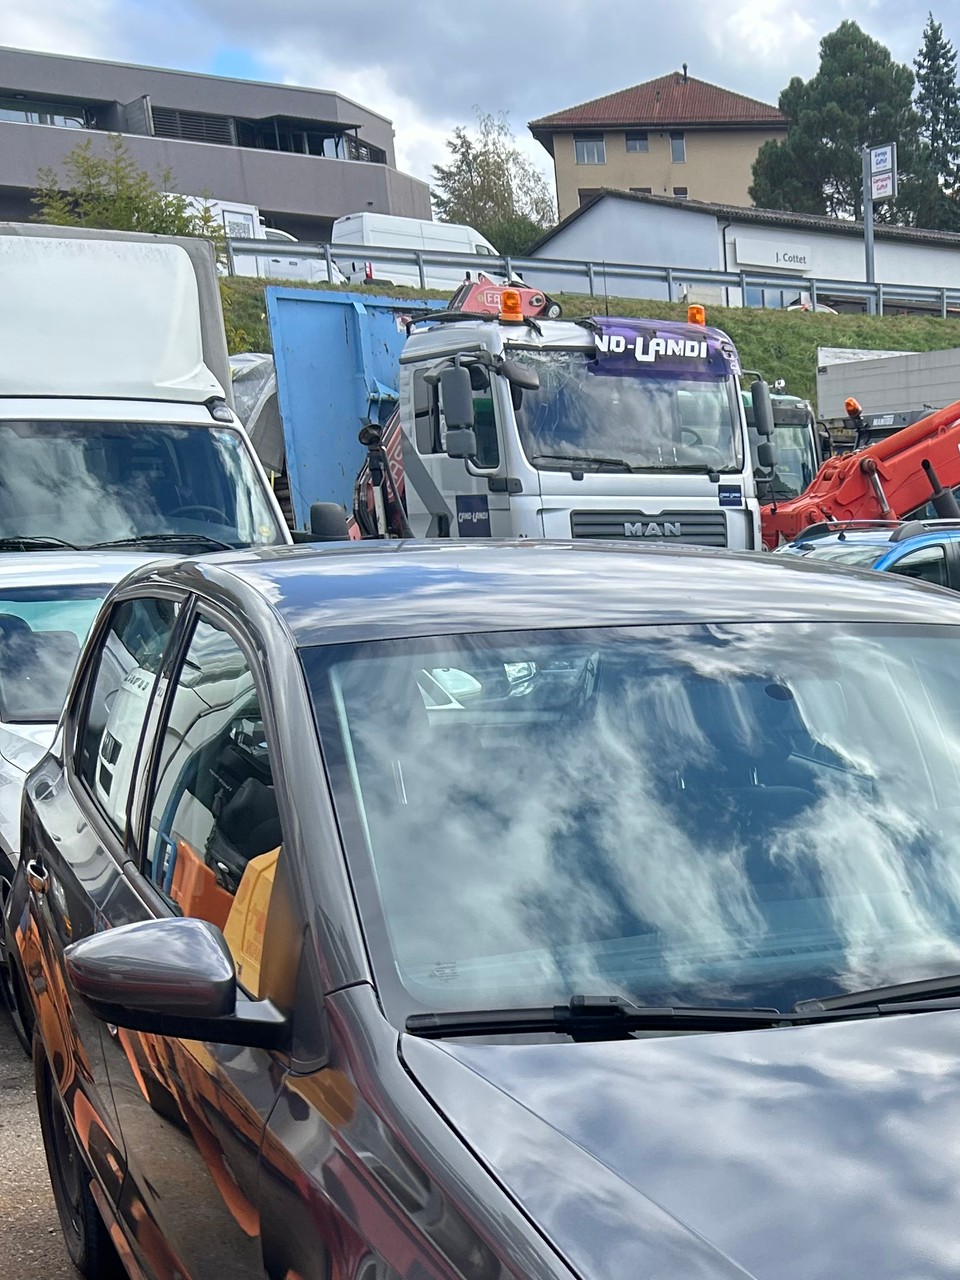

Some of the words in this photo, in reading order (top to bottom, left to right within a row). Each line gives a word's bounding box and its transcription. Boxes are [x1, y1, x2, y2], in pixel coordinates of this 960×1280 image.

[783, 252, 807, 265] Cottet
[487, 293, 501, 305] FA
[594, 334, 708, 362] ND-LANDI
[623, 522, 681, 537] MAN
